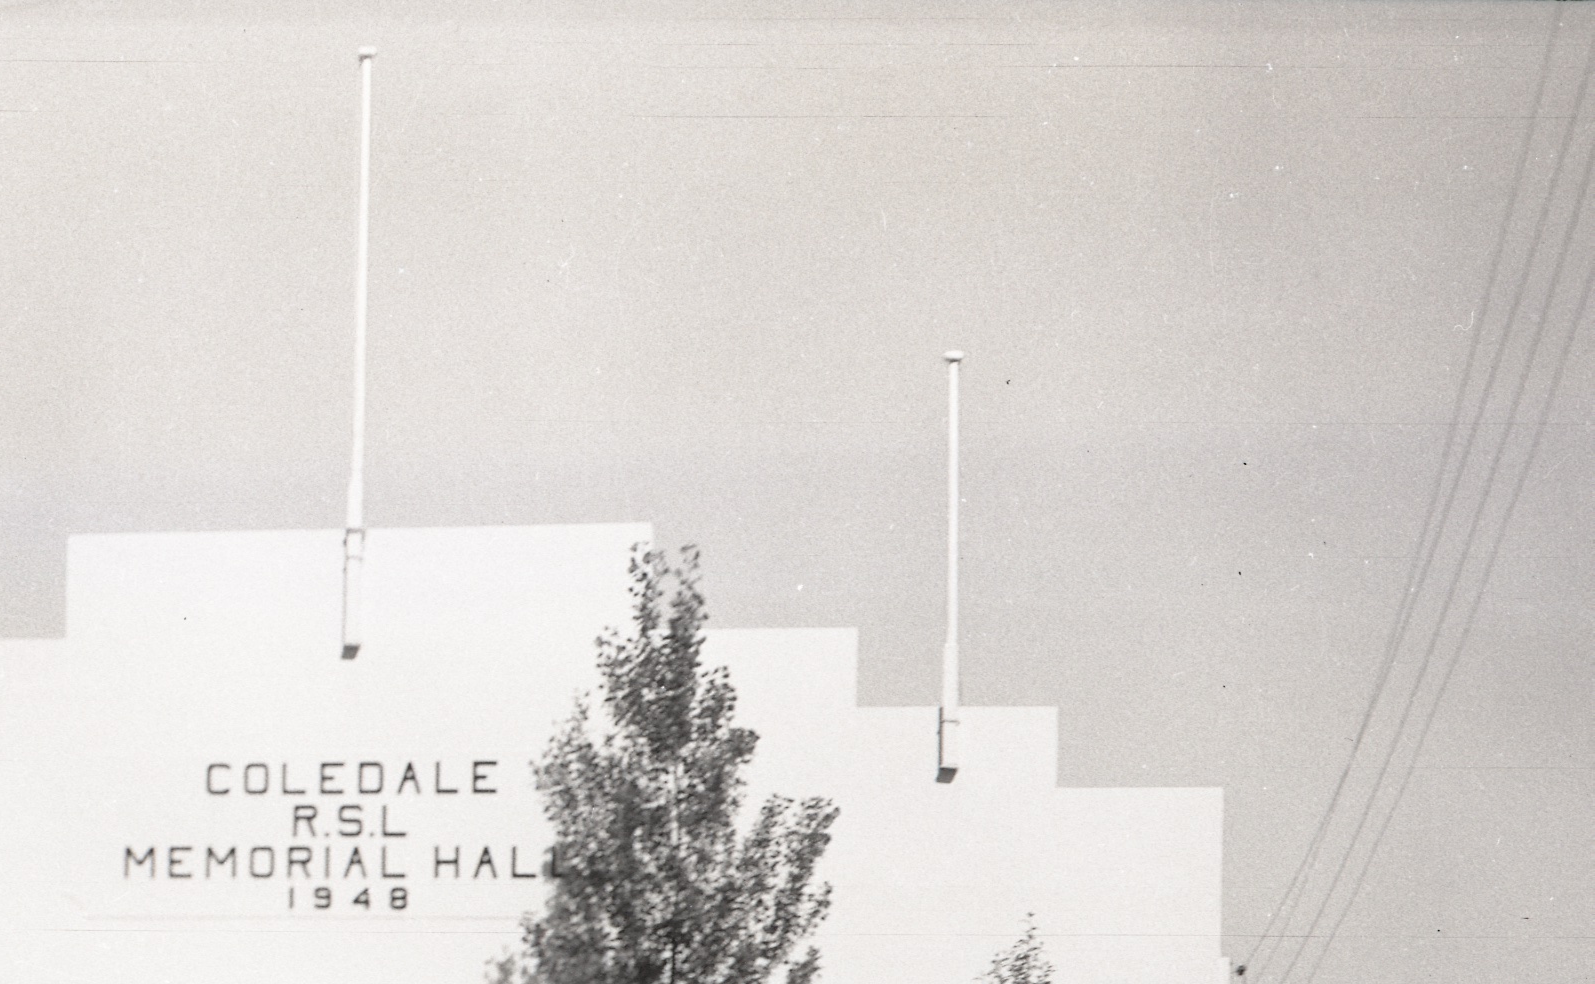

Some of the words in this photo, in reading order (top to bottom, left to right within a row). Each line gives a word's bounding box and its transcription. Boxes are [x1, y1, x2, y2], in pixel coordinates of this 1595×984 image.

[206, 760, 498, 795] COLEDALE
[292, 804, 408, 838] R.S.L
[124, 845, 407, 879] MEMORIAL
[433, 845, 566, 879] HALL
[288, 886, 408, 910] 1948
